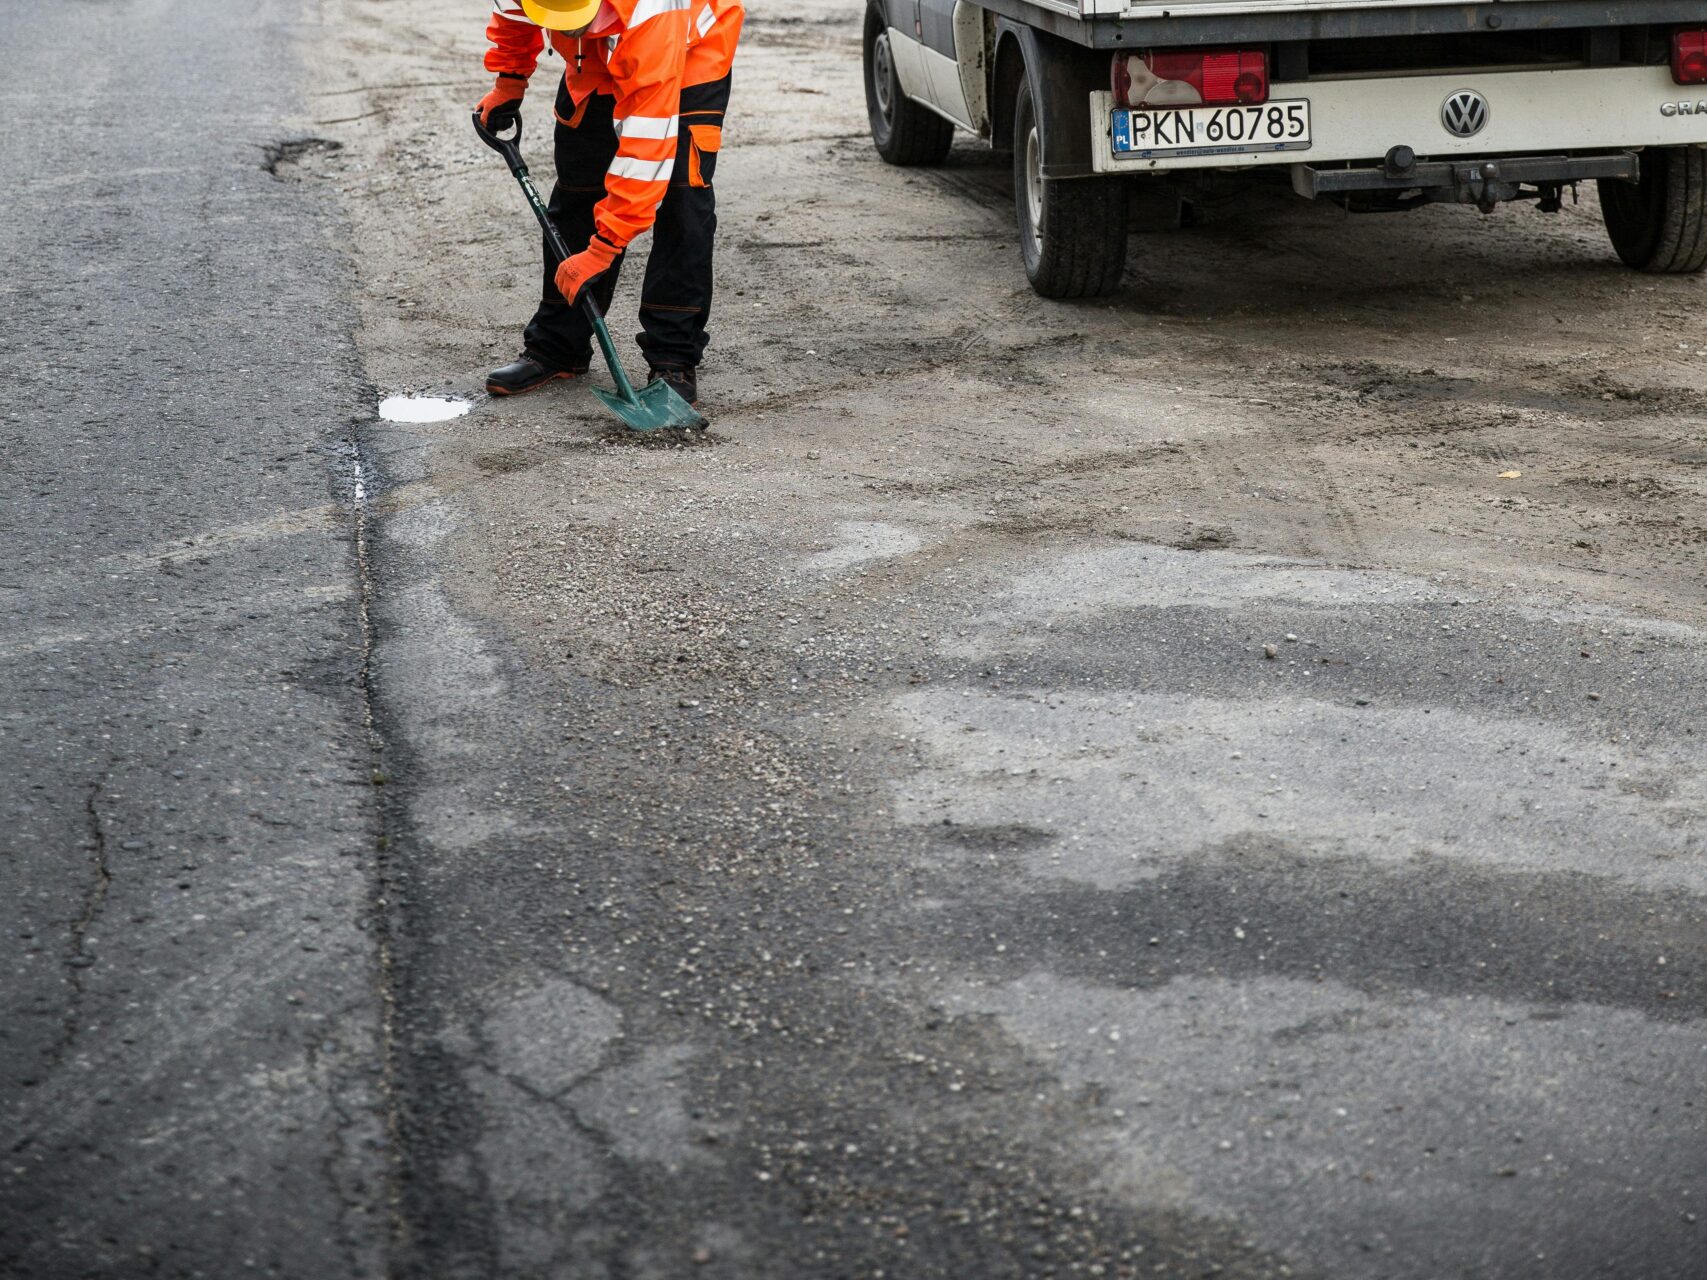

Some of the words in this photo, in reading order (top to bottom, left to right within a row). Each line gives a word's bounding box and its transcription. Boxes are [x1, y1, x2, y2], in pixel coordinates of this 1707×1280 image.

[1132, 110, 1195, 146] PKN
[1206, 105, 1303, 142] 60785
[1116, 135, 1129, 145] PL
